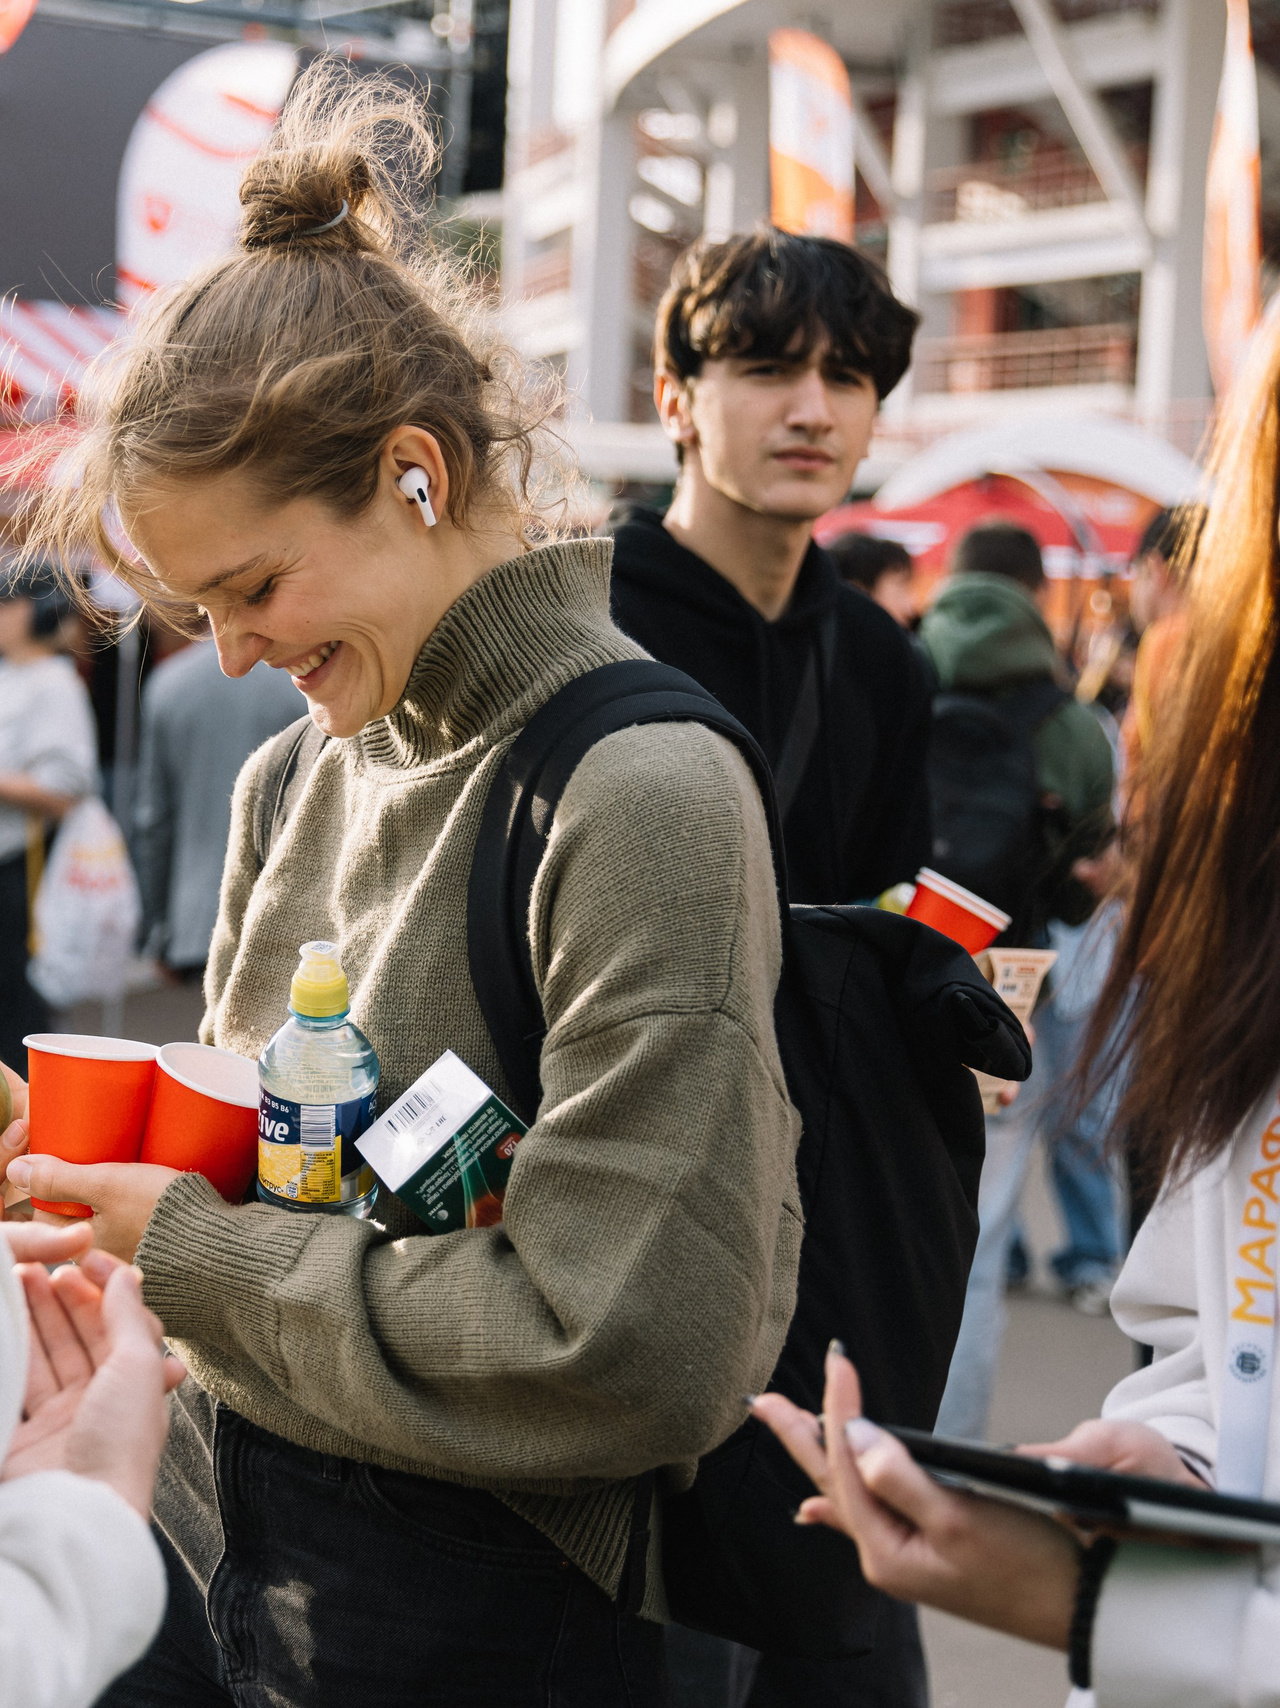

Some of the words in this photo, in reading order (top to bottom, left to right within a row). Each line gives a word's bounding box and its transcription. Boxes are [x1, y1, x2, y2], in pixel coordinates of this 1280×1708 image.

[280, 1104, 289, 1113] B6
[502, 1139, 519, 1156] 120
[1231, 1092, 1280, 1326] МАРАФ
